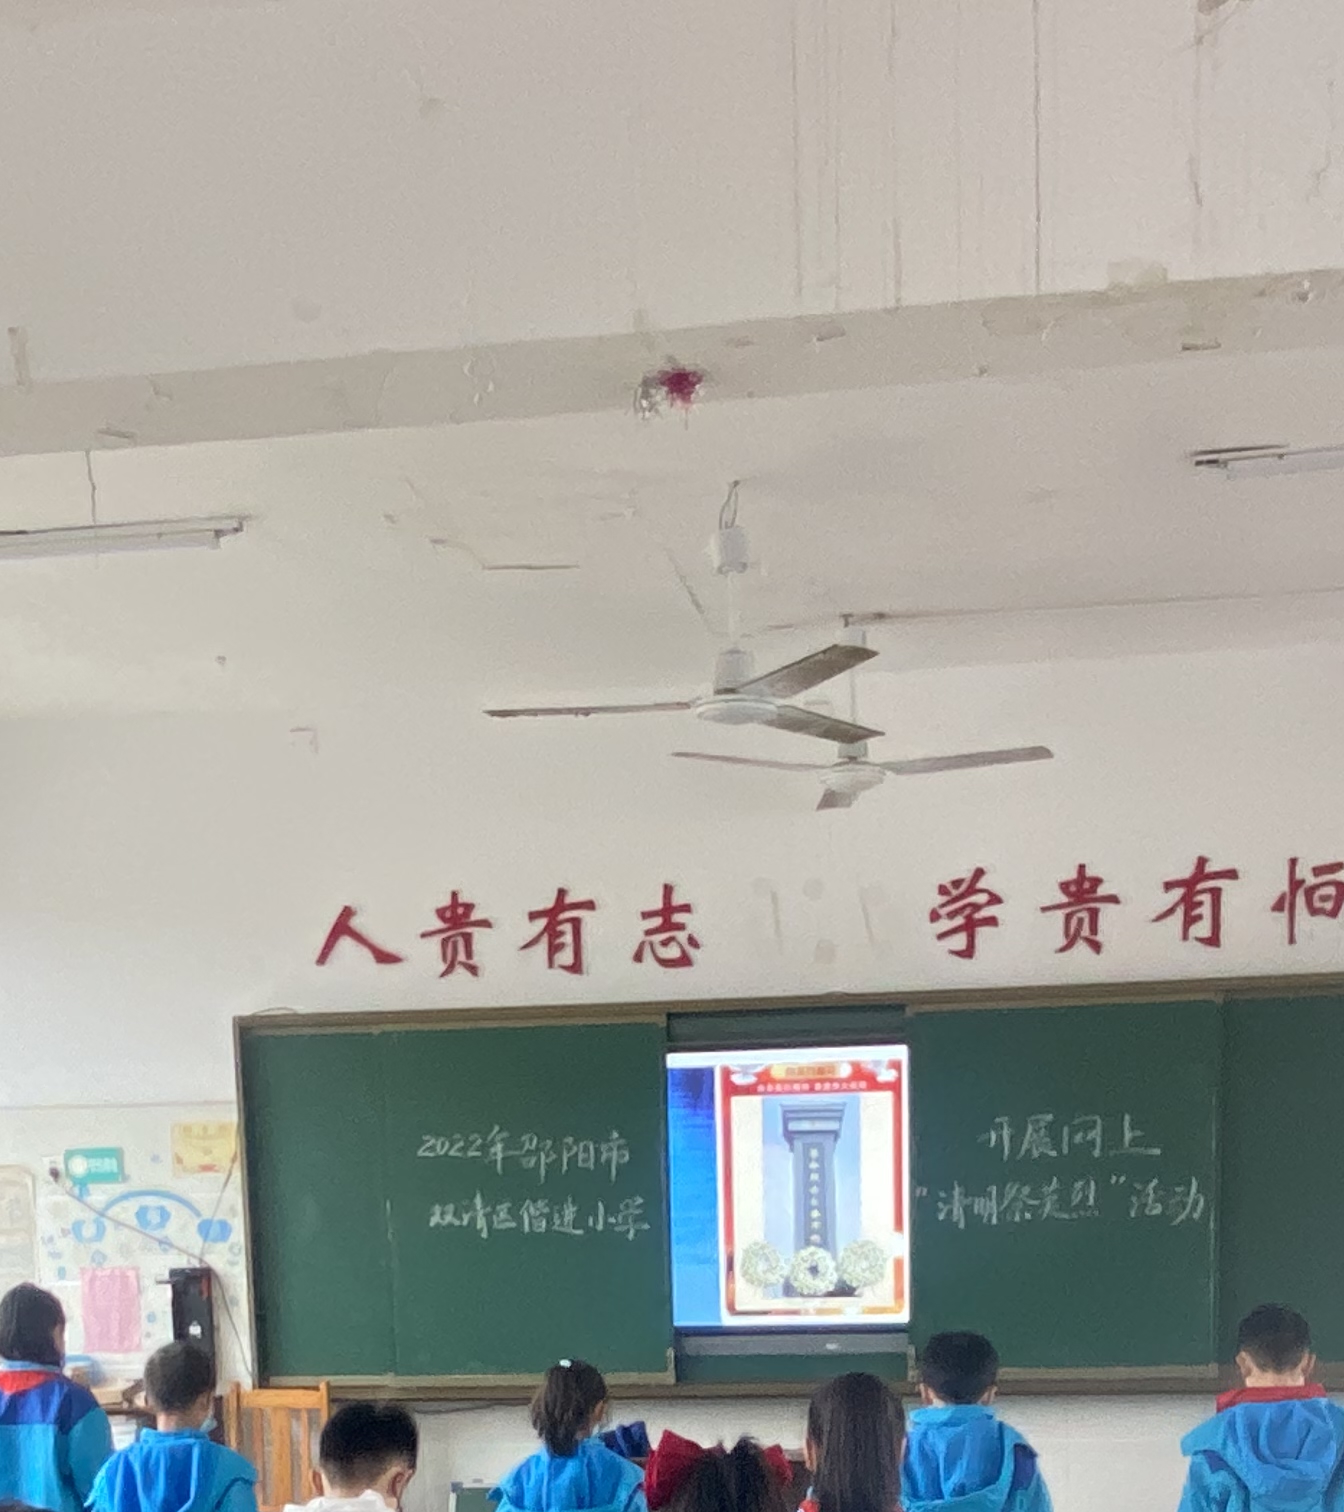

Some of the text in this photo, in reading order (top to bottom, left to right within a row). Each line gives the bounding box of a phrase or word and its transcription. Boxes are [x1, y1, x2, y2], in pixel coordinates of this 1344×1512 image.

[316, 882, 700, 978] 人贵有志
[416, 1124, 631, 1184] 2022年邵阳市
